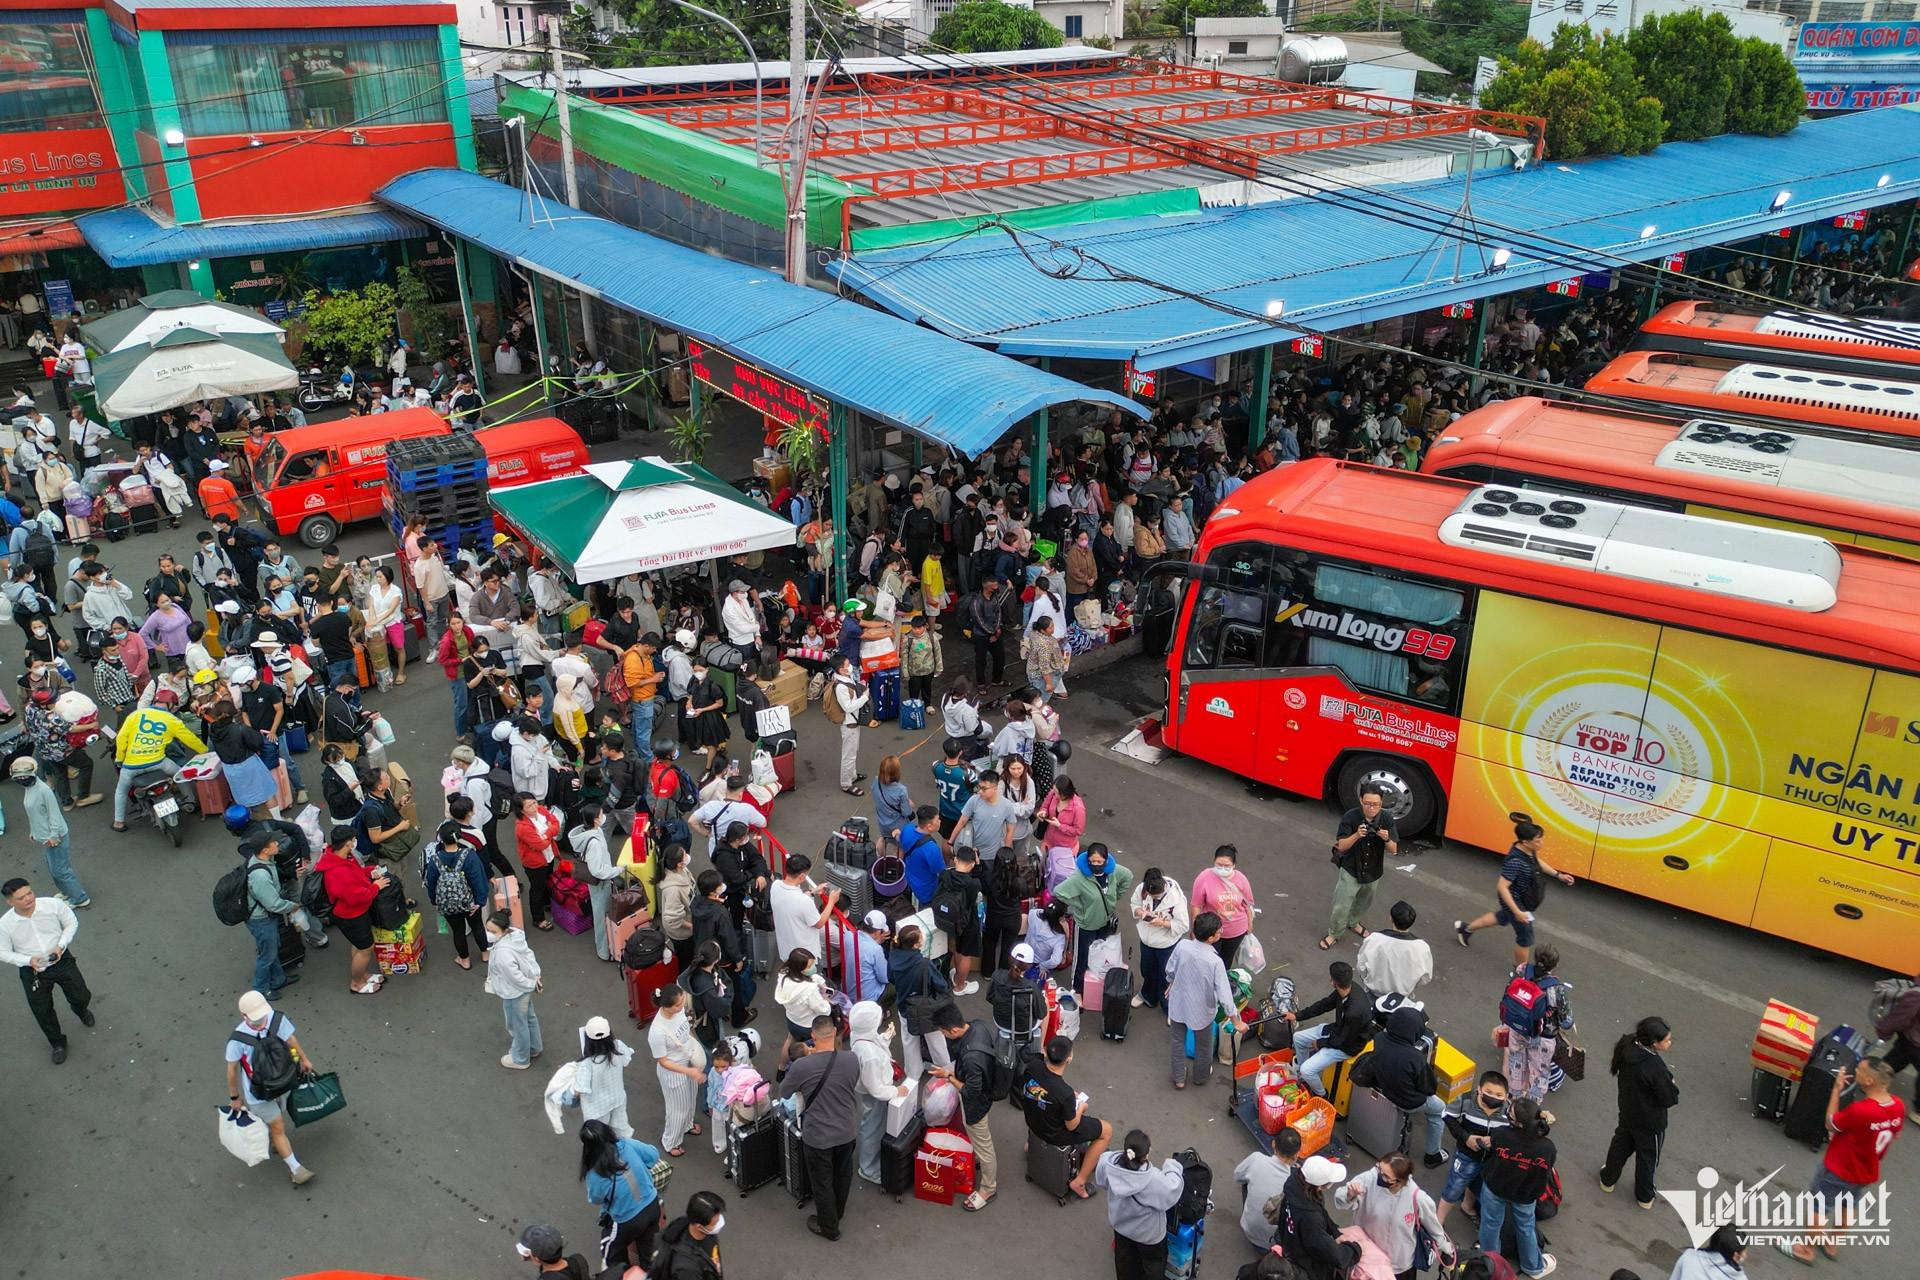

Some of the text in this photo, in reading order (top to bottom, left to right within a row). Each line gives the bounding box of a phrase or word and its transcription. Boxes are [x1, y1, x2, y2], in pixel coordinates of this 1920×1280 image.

[1803, 24, 1920, 48] QUÁN CƠM D
[30, 152, 103, 172] Lines
[1557, 283, 1568, 294] 10
[1300, 341, 1314, 355] 08
[172, 363, 193, 373] FUTA
[1133, 380, 1146, 394] 07
[500, 458, 524, 471] FUTA
[643, 502, 716, 521] FUTA Bus Lines
[639, 556, 660, 567] Tổng
[662, 553, 676, 563] Đài
[678, 550, 693, 560] Đặt
[710, 543, 728, 554] 1900
[729, 540, 747, 549] 6067
[1207, 705, 1218, 713] LONG
[1214, 698, 1225, 708] 31
[139, 713, 167, 736] be
[1345, 701, 1384, 724] FUTA
[1385, 712, 1414, 731] Bus
[1416, 719, 1456, 742] Lines
[1578, 722, 1630, 743] VIETNAM
[1377, 733, 1394, 743] 1900
[1396, 738, 1413, 747] 6067
[1576, 731, 1665, 765] TOP 10
[1572, 751, 1656, 781] BANKING
[1788, 753, 1904, 800] NGÂN
[1569, 772, 1655, 801] AWARD 2025
[1571, 764, 1656, 792] REPUTATION
[938, 779, 960, 802] 27
[1783, 783, 1917, 828] THƯƠNG MẠI
[1832, 821, 1884, 852] UY
[1818, 876, 1830, 885] Do
[1833, 880, 1867, 895] Vietnam
[1869, 890, 1899, 904] Report
[1496, 1147, 1510, 1159] The
